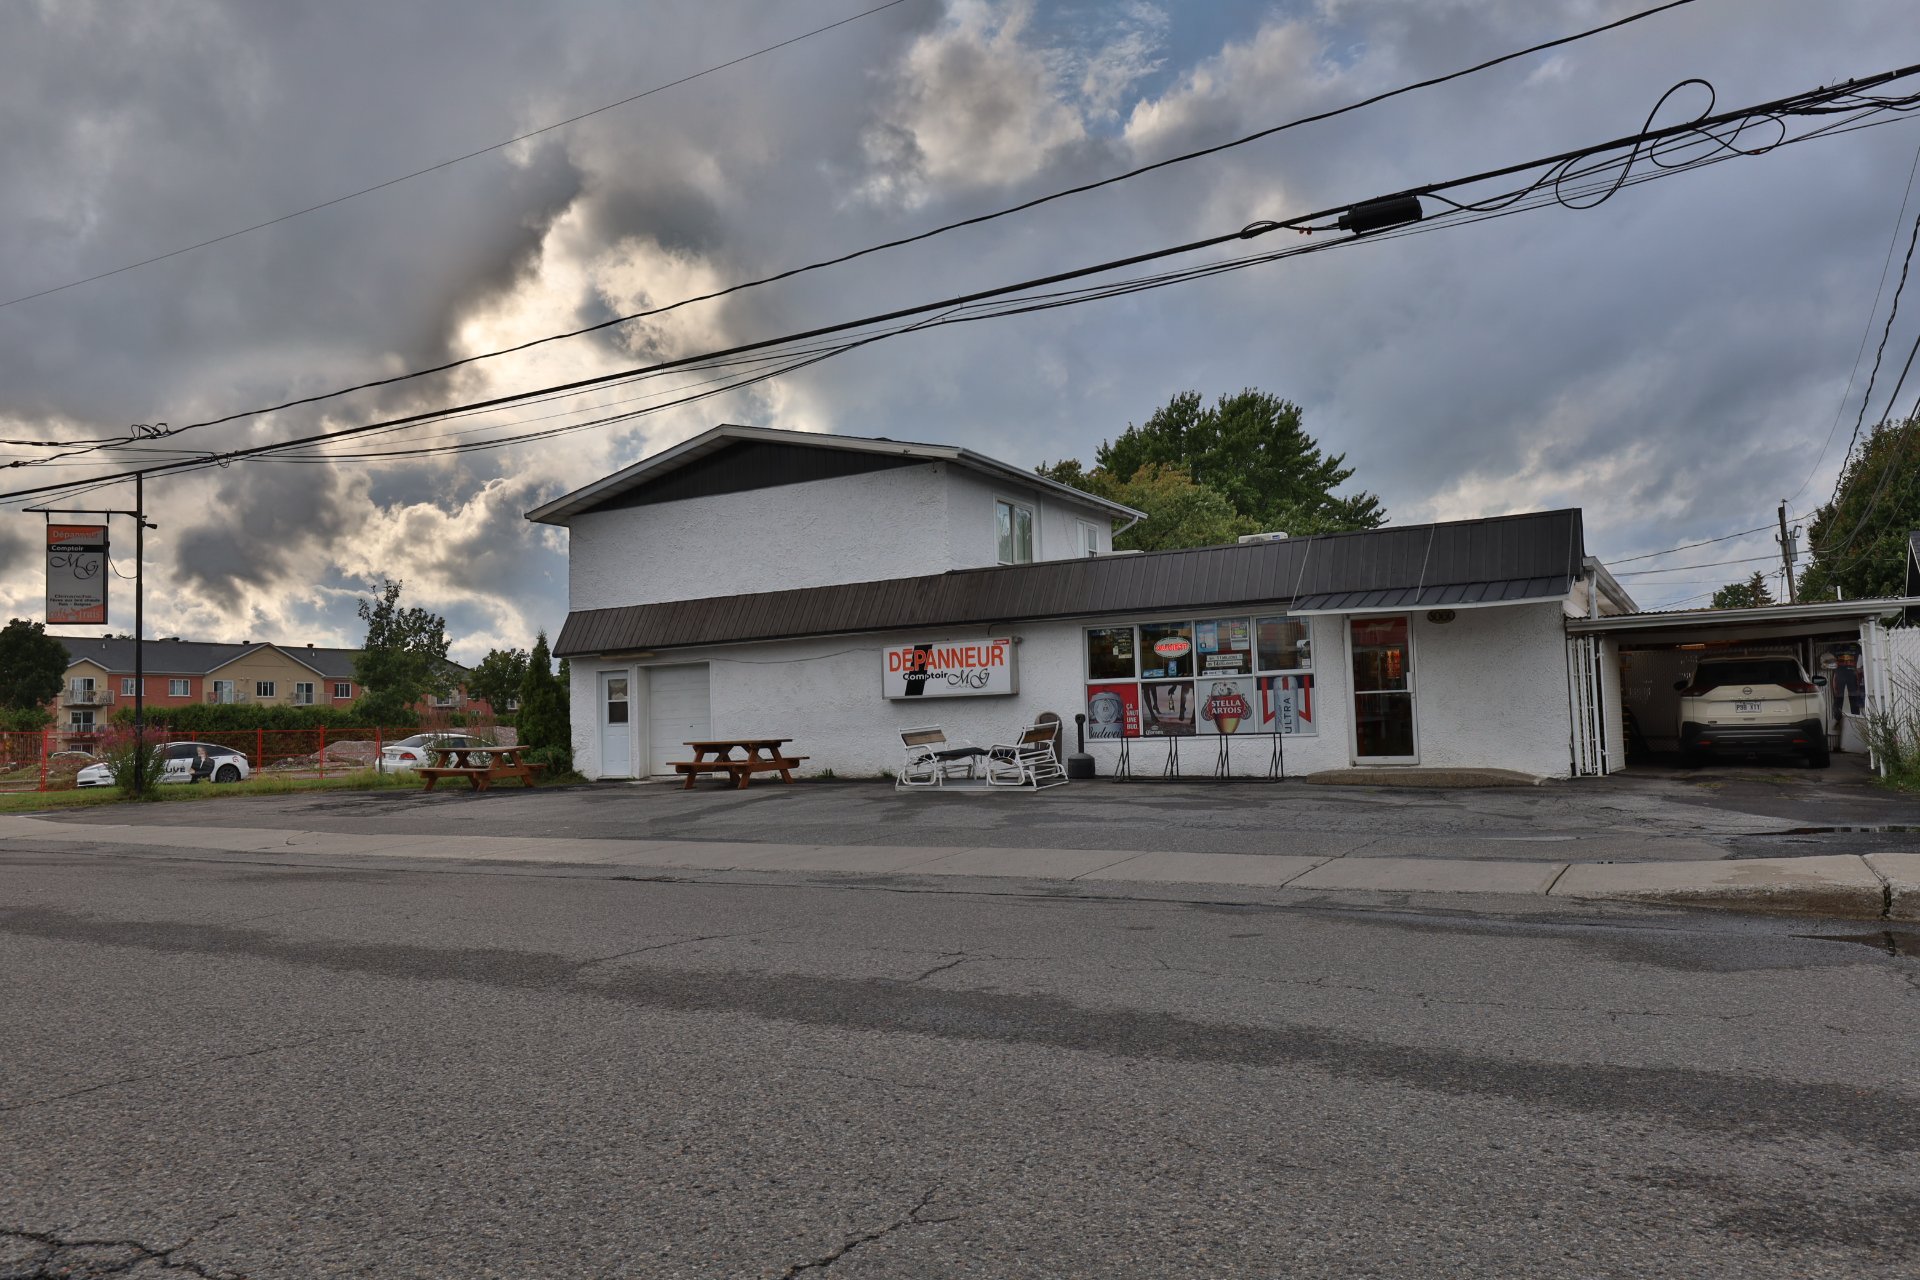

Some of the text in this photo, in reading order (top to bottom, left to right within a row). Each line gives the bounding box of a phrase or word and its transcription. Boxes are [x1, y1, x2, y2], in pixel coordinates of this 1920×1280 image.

[52, 530, 98, 540] Dépanneur
[889, 645, 1004, 673] DÉPANNEUR
[903, 672, 949, 681] Comptoir
[1283, 697, 1293, 734] ULTRA
